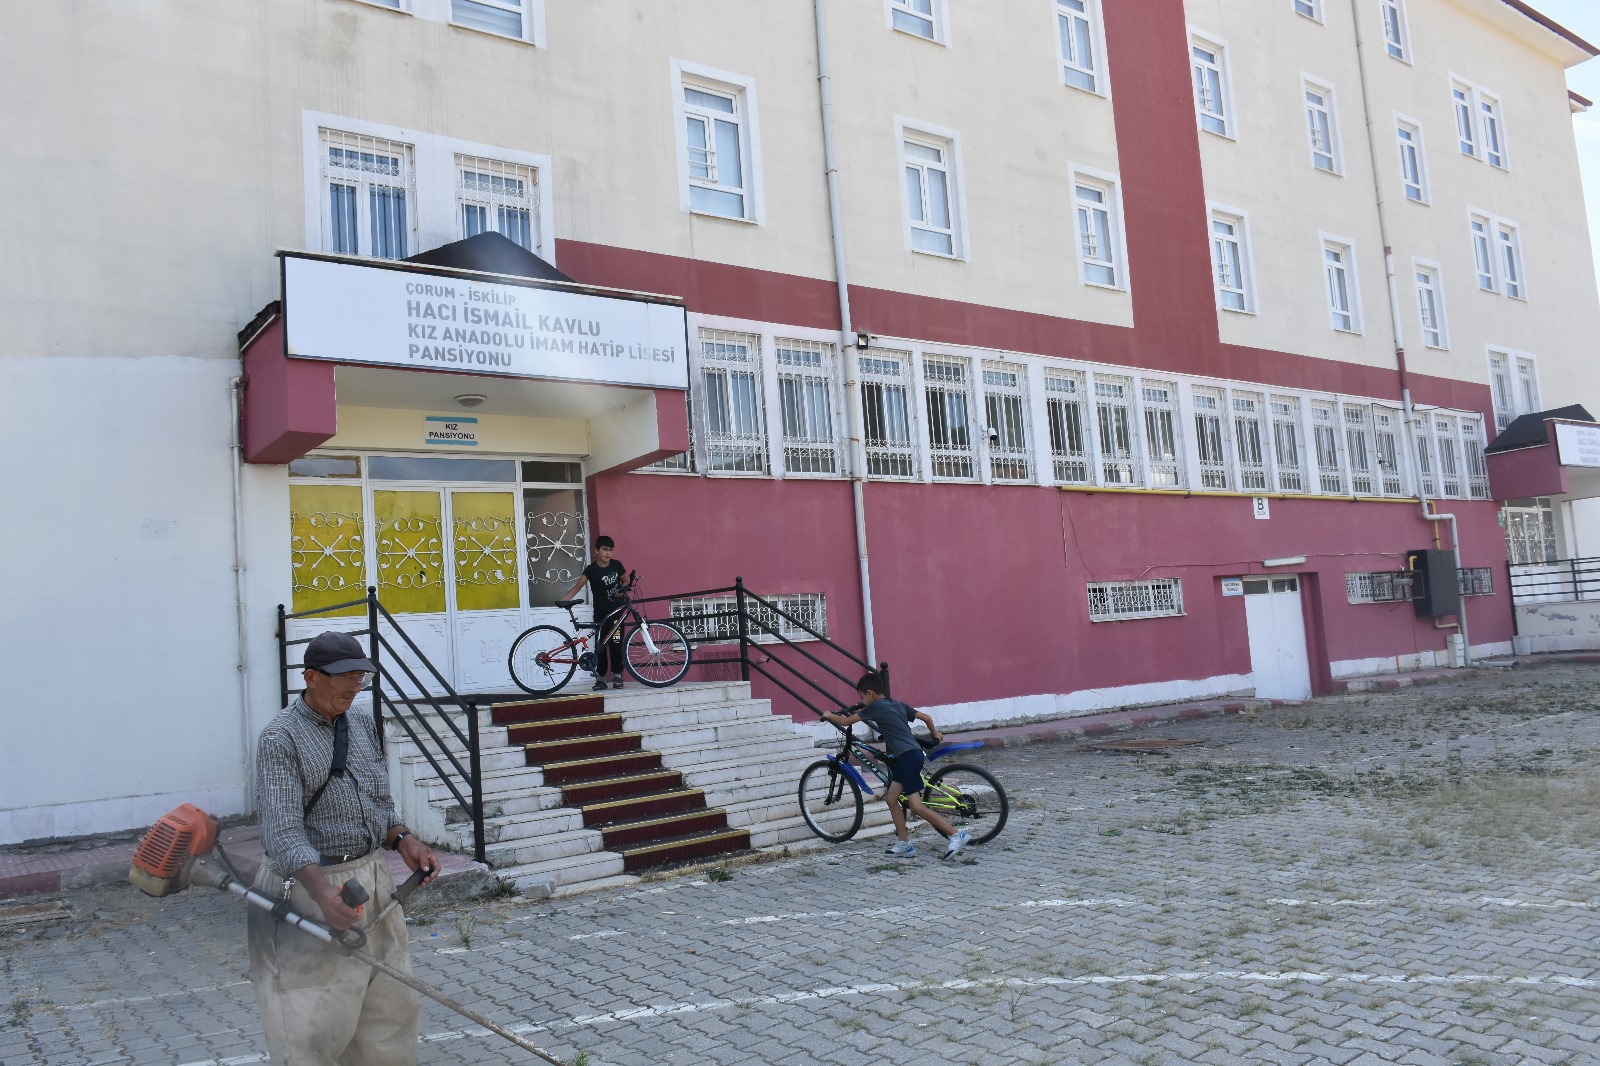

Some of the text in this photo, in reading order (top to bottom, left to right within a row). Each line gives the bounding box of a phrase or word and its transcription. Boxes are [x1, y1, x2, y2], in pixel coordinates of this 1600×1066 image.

[406, 282, 456, 299] ÇORUM
[468, 286, 516, 306] İSKİLİP
[406, 299, 600, 337] HACI İSMAİL KAVLU
[407, 322, 675, 363] KIZ ANADOLU İMAM HATİP LİSESİ
[408, 343, 512, 367] PANSİYONU
[428, 431, 475, 440] PANSİYONU
[445, 423, 458, 431] KIZ
[1257, 498, 1264, 510] B
